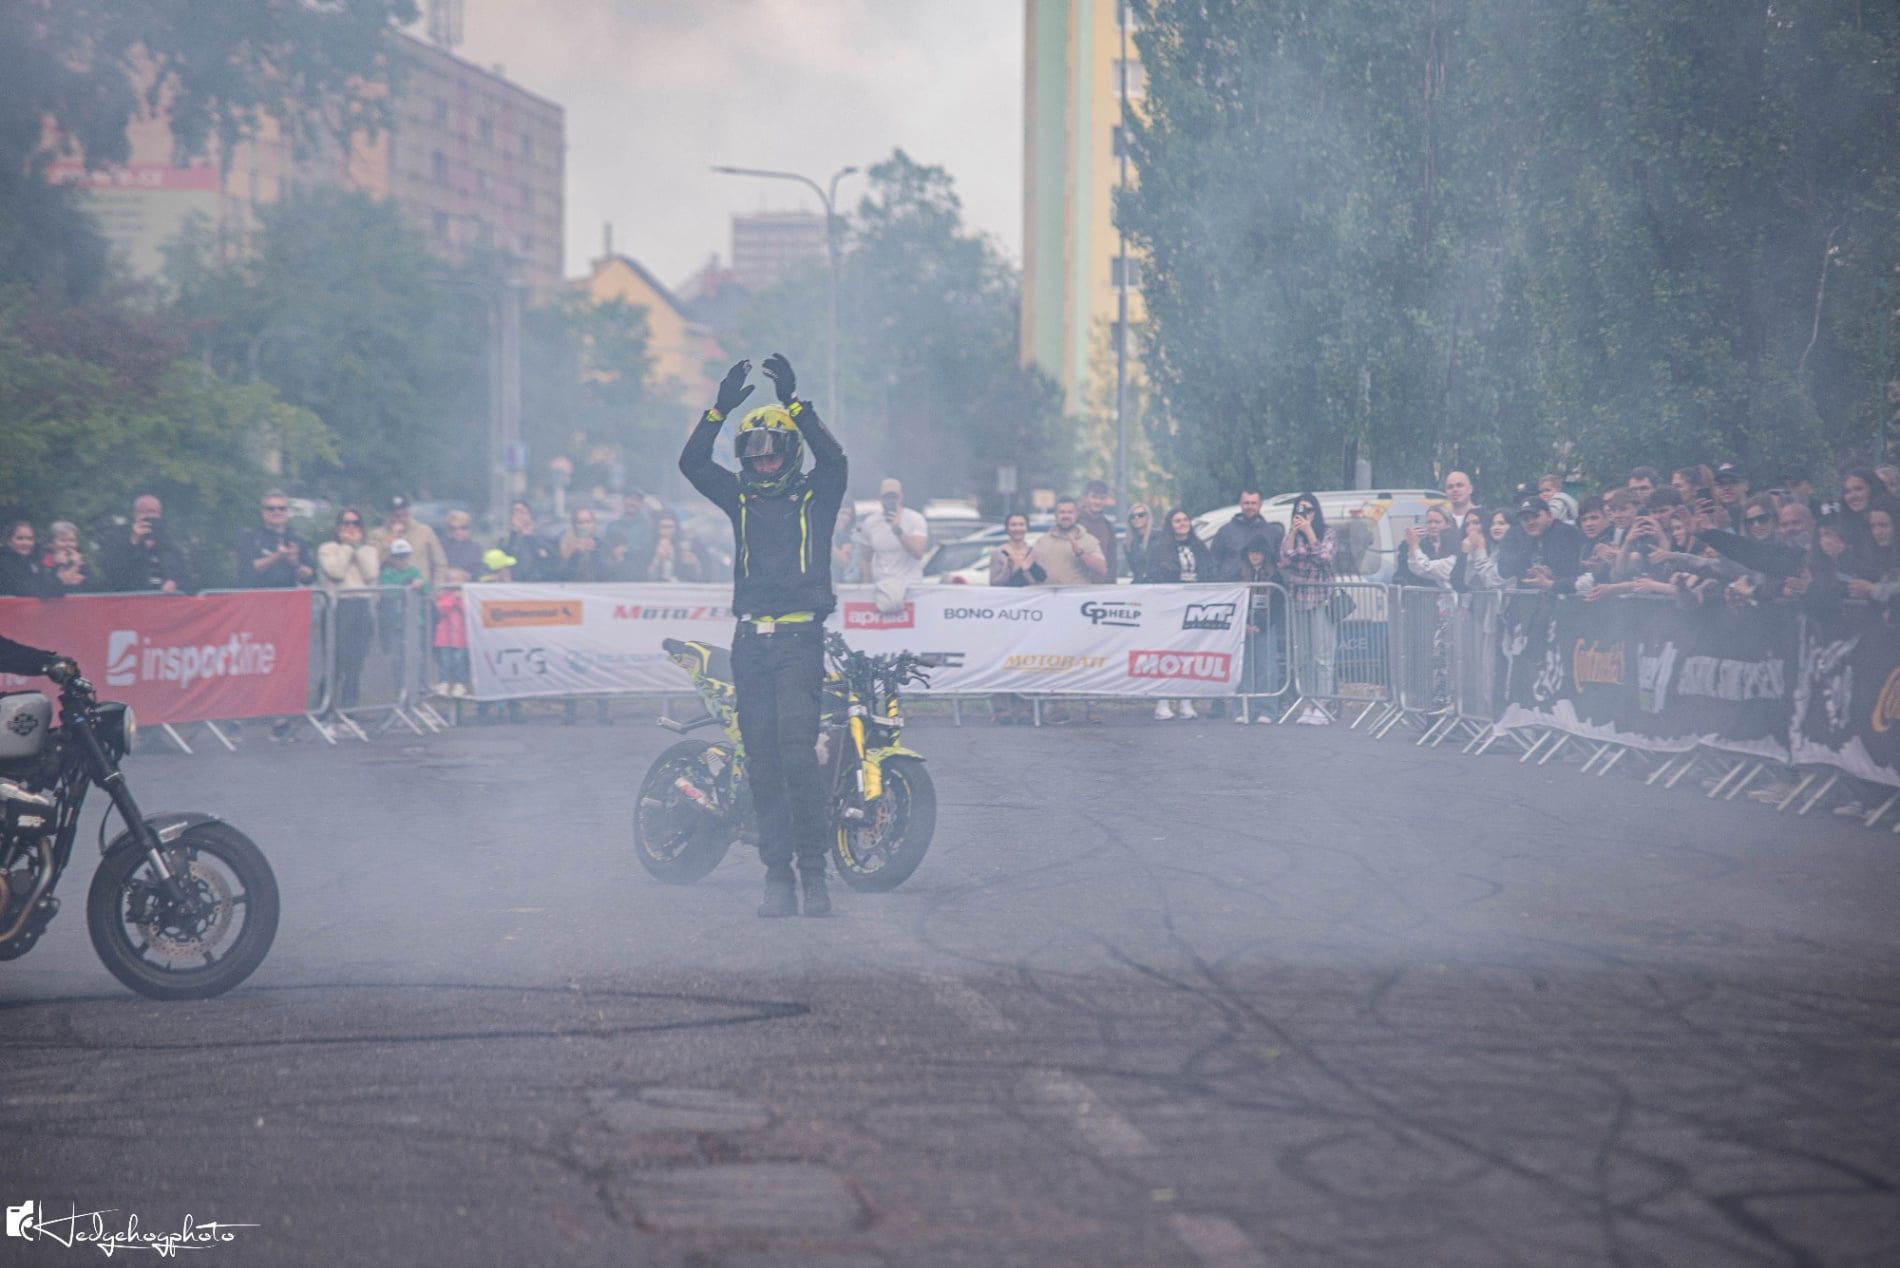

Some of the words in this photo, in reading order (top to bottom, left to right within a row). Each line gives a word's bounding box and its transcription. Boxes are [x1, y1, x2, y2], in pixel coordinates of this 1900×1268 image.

[944, 608, 994, 620] BONO
[998, 608, 1043, 622] AUTO
[1108, 608, 1141, 620] HELP
[1132, 655, 1226, 678] MOTUL
